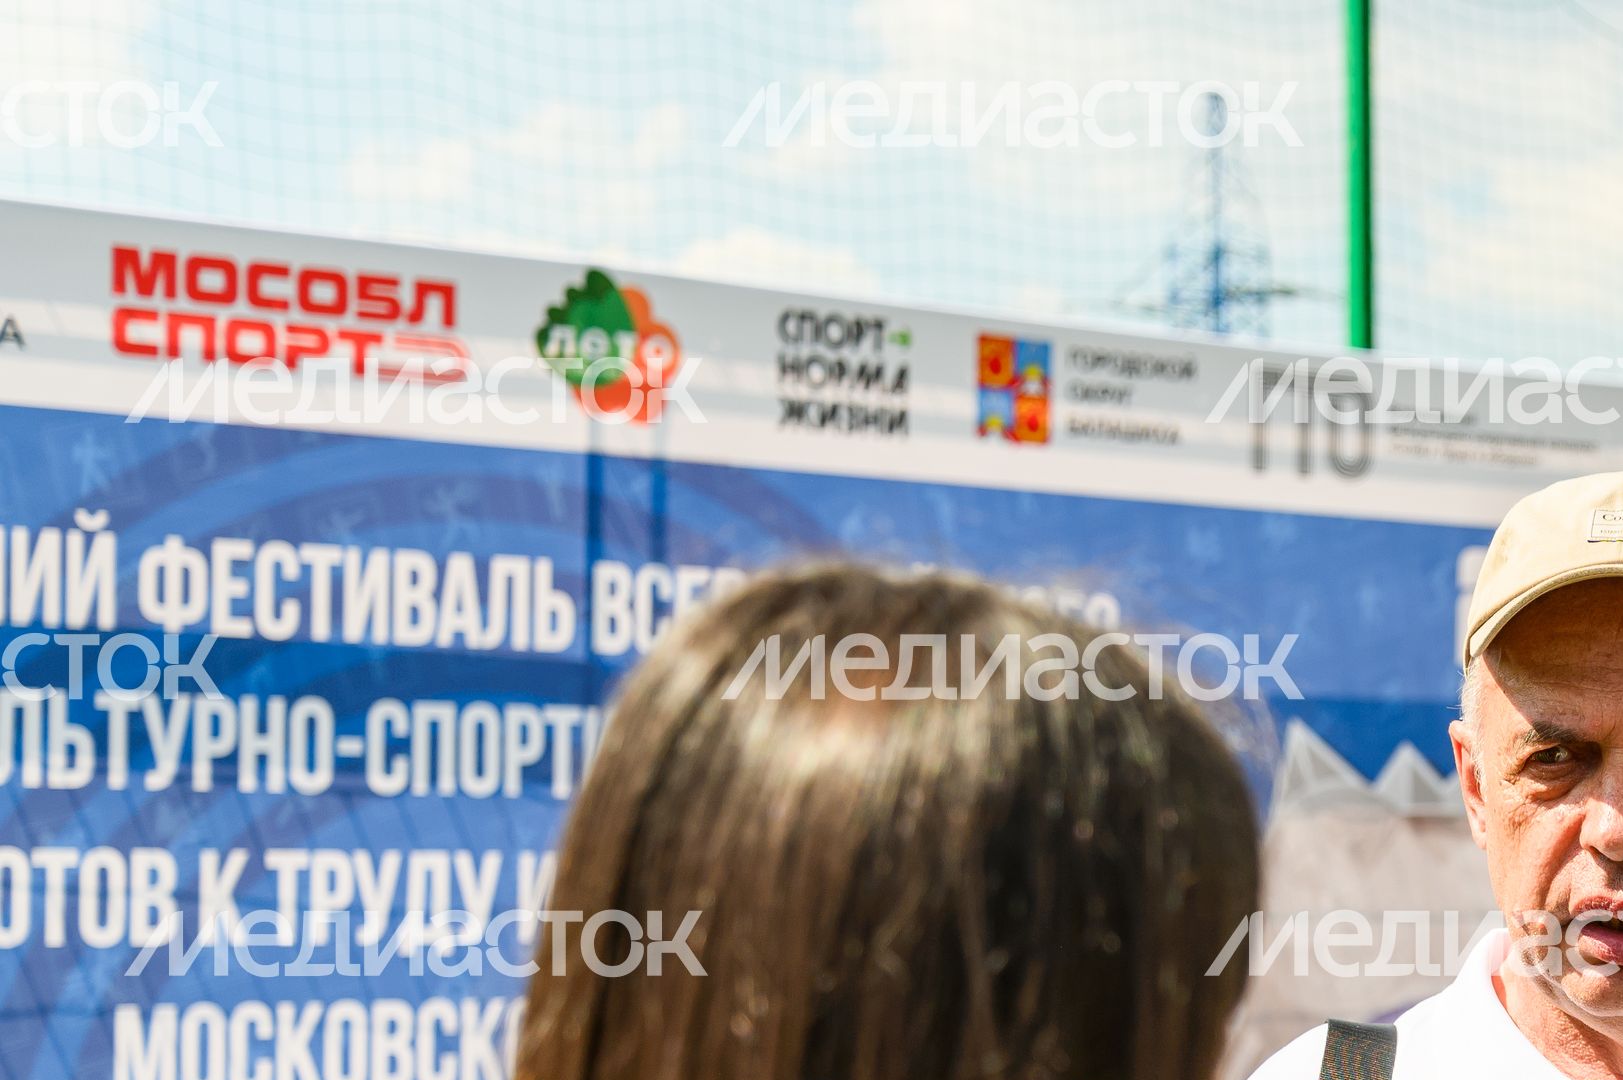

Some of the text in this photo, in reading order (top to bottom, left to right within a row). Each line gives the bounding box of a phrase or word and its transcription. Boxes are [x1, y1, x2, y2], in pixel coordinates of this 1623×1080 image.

[111, 244, 458, 329] МОСОБЛ
[111, 306, 385, 380] СПОРТ
[776, 308, 888, 351] СПОРТ
[776, 353, 910, 394] НОРМА
[777, 402, 910, 438] ЖИЗНИ
[0, 507, 117, 632] ИЙ
[138, 533, 577, 653] ФЕСТИВАЛЬ
[199, 847, 251, 948] К
[265, 849, 503, 957] ТРУДУ
